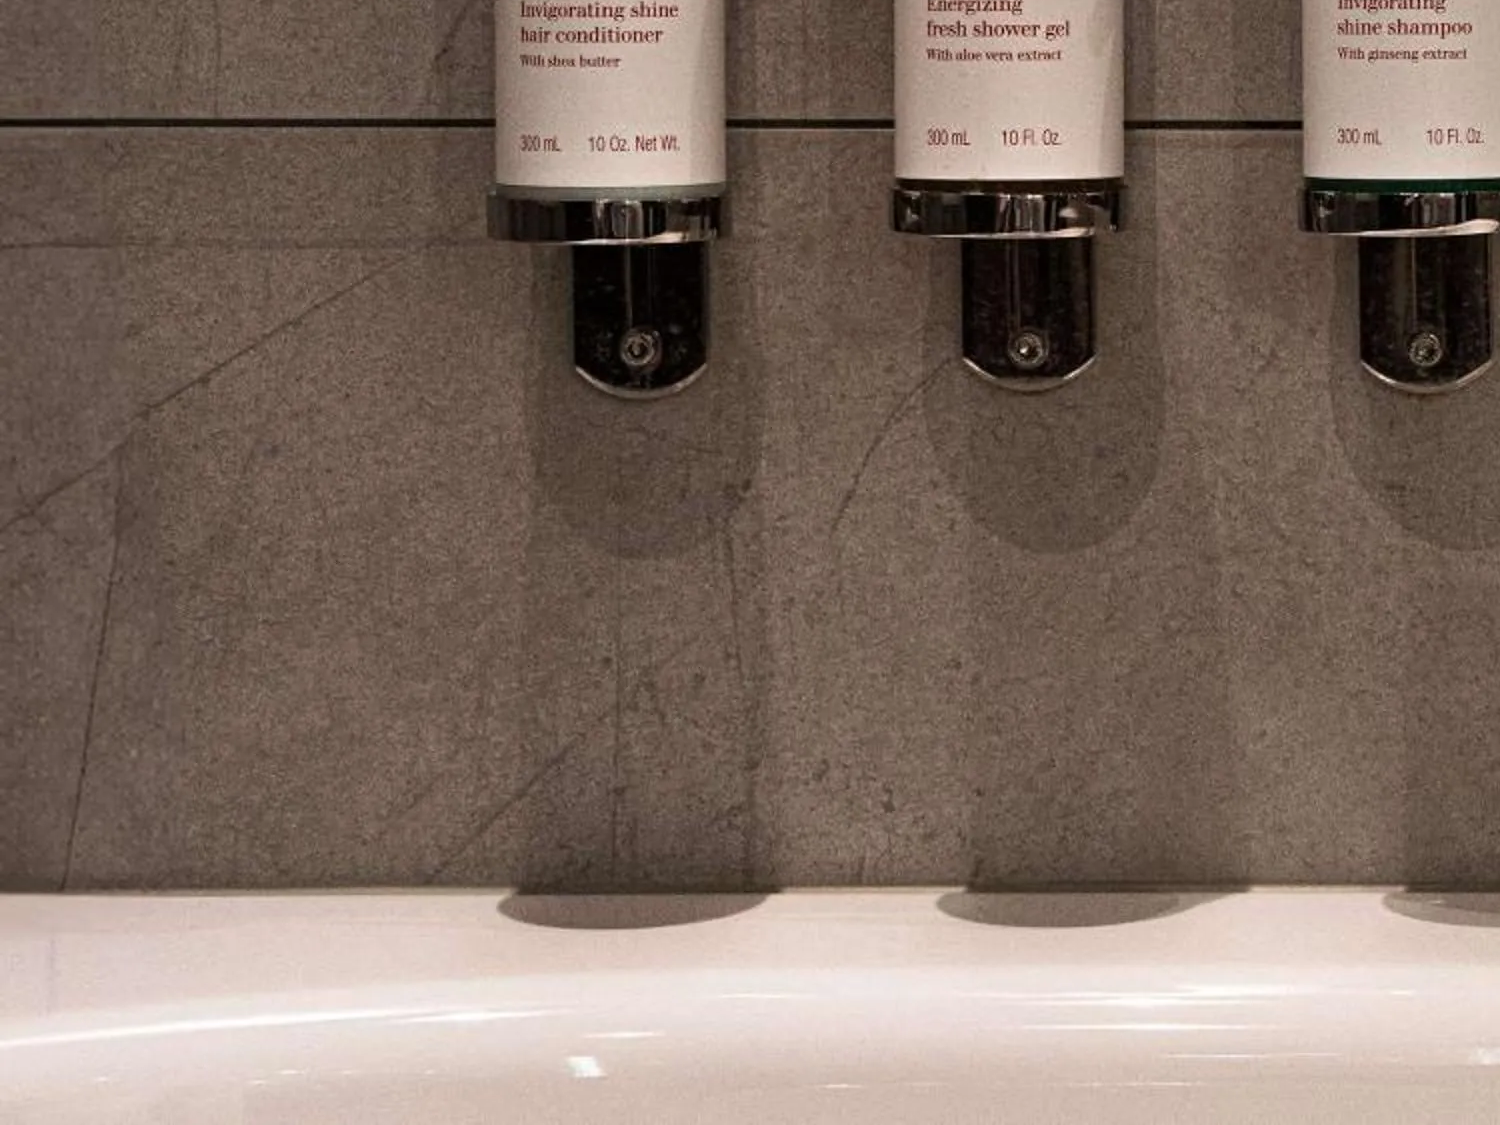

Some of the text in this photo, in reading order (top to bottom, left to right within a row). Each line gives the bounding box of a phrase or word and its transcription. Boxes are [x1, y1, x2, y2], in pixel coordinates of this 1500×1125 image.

[520, 0, 679, 21] Invigorating shine
[520, 26, 663, 44] hair conditioner
[927, 19, 1071, 41] fresh shower gel
[1337, 19, 1473, 39] shine shampoo
[519, 55, 621, 68] With shea butter
[926, 48, 1062, 61] With aloe vera extract
[1337, 46, 1467, 62] With ginseng extract
[520, 134, 540, 152] 300
[543, 135, 561, 152] mL
[588, 135, 605, 152] 10
[609, 135, 631, 152] Oz.
[635, 134, 657, 151] Net
[927, 129, 948, 146] 300
[1002, 129, 1019, 146] 10
[1337, 128, 1360, 145] 300
[1427, 128, 1444, 145] 10
